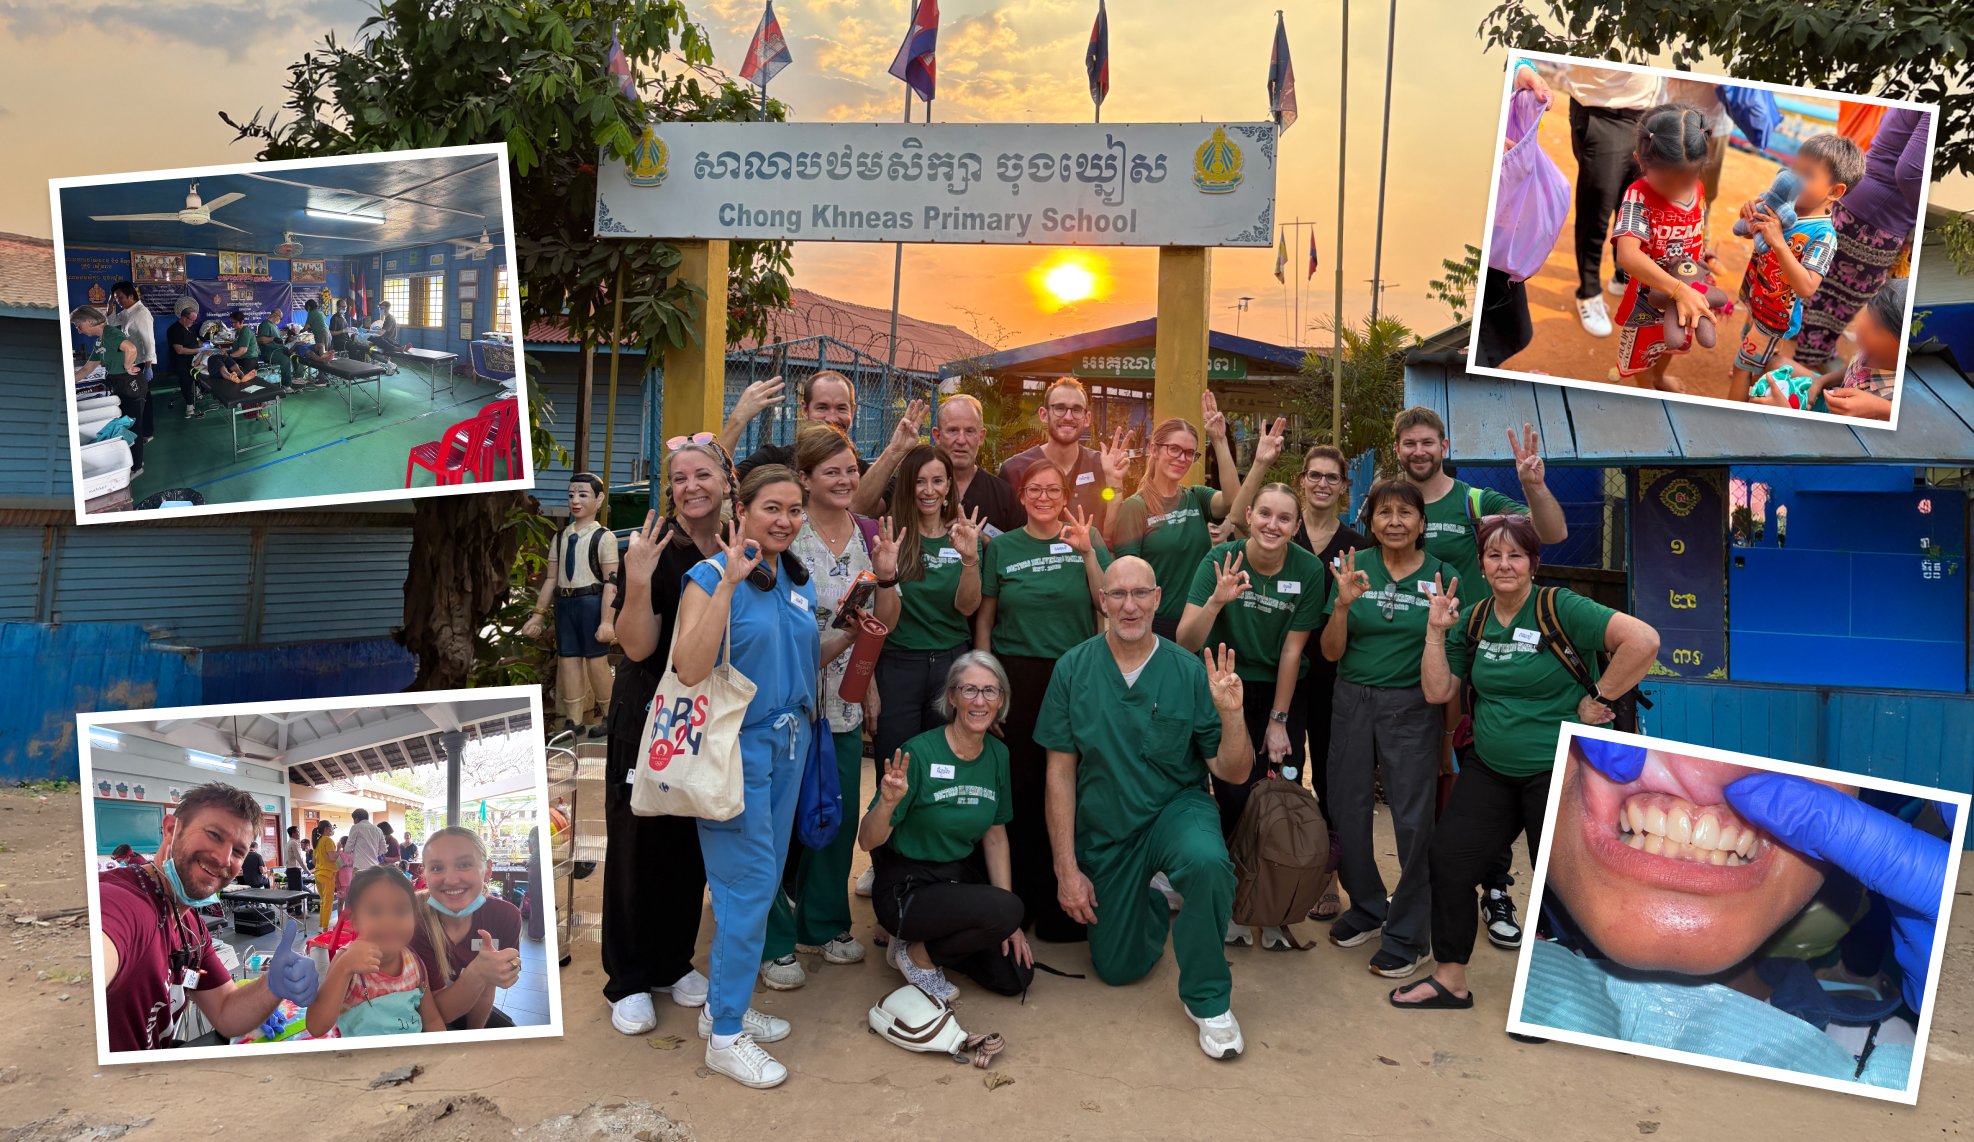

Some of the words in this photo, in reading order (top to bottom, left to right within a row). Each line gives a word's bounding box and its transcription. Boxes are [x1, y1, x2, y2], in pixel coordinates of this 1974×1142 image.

[694, 137, 982, 195] សាលាបឋមសិក្សា
[718, 202, 801, 233] Chong
[811, 204, 914, 230] Khneas
[923, 205, 1033, 238] Primary
[1041, 207, 1137, 233] School
